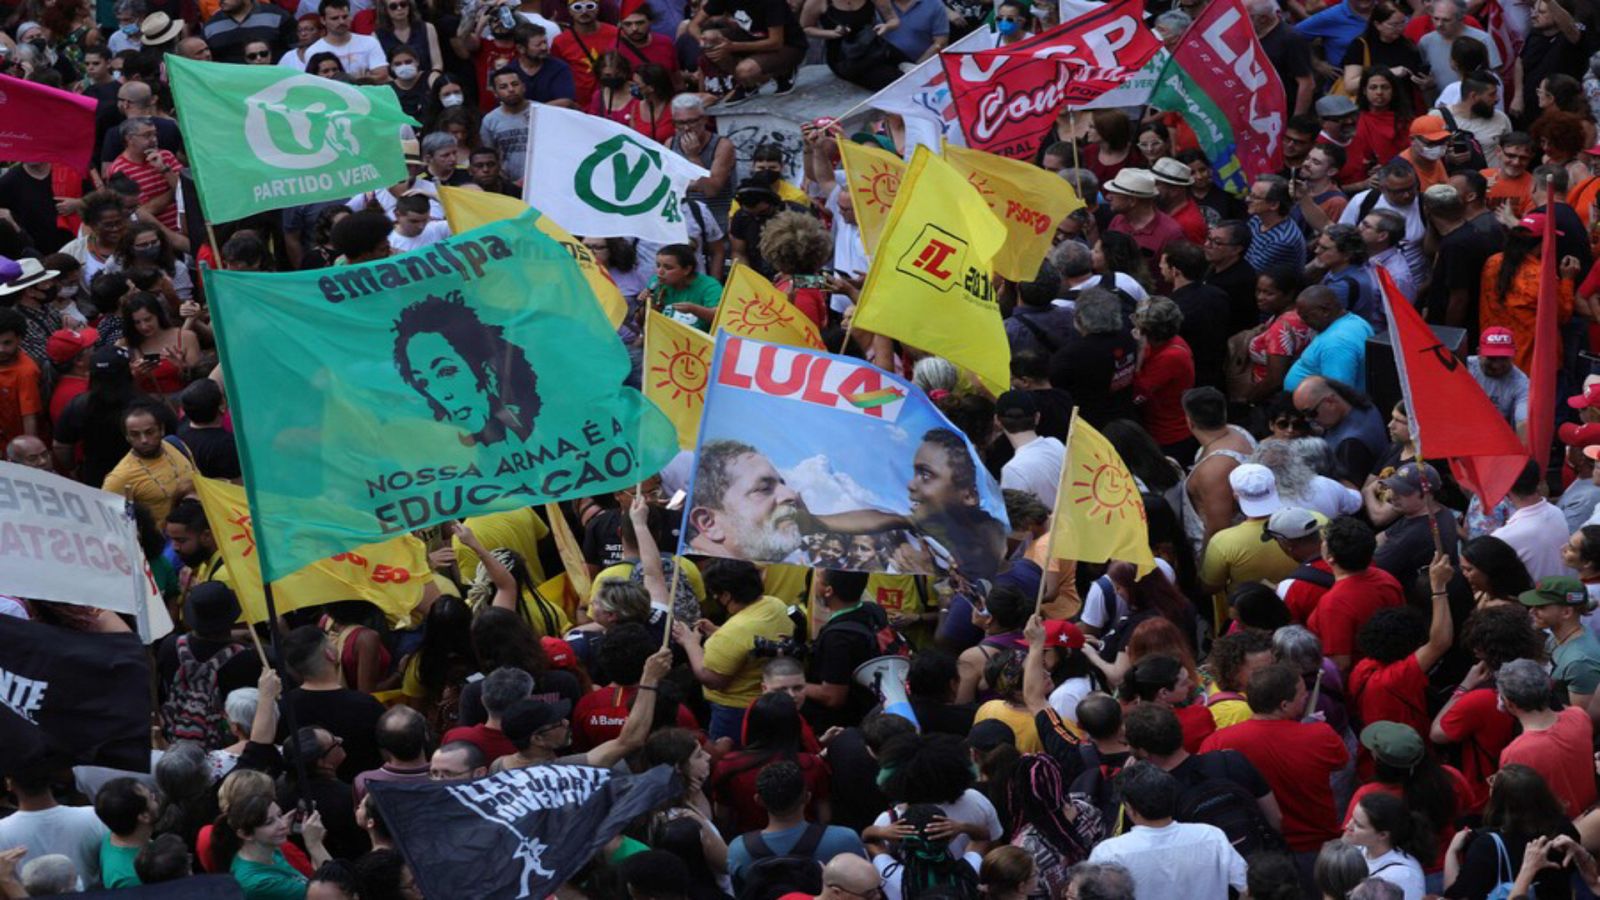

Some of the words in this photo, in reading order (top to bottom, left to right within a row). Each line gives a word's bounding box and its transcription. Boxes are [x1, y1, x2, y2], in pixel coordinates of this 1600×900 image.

[253, 173, 334, 202] PARTIDO
[318, 234, 512, 303] emancipa
[718, 337, 883, 418] LULA
[365, 461, 484, 499] NOSSA
[496, 437, 581, 477] ARMA
[582, 420, 606, 447] É
[375, 441, 640, 535] EDUCAÇÃO!
